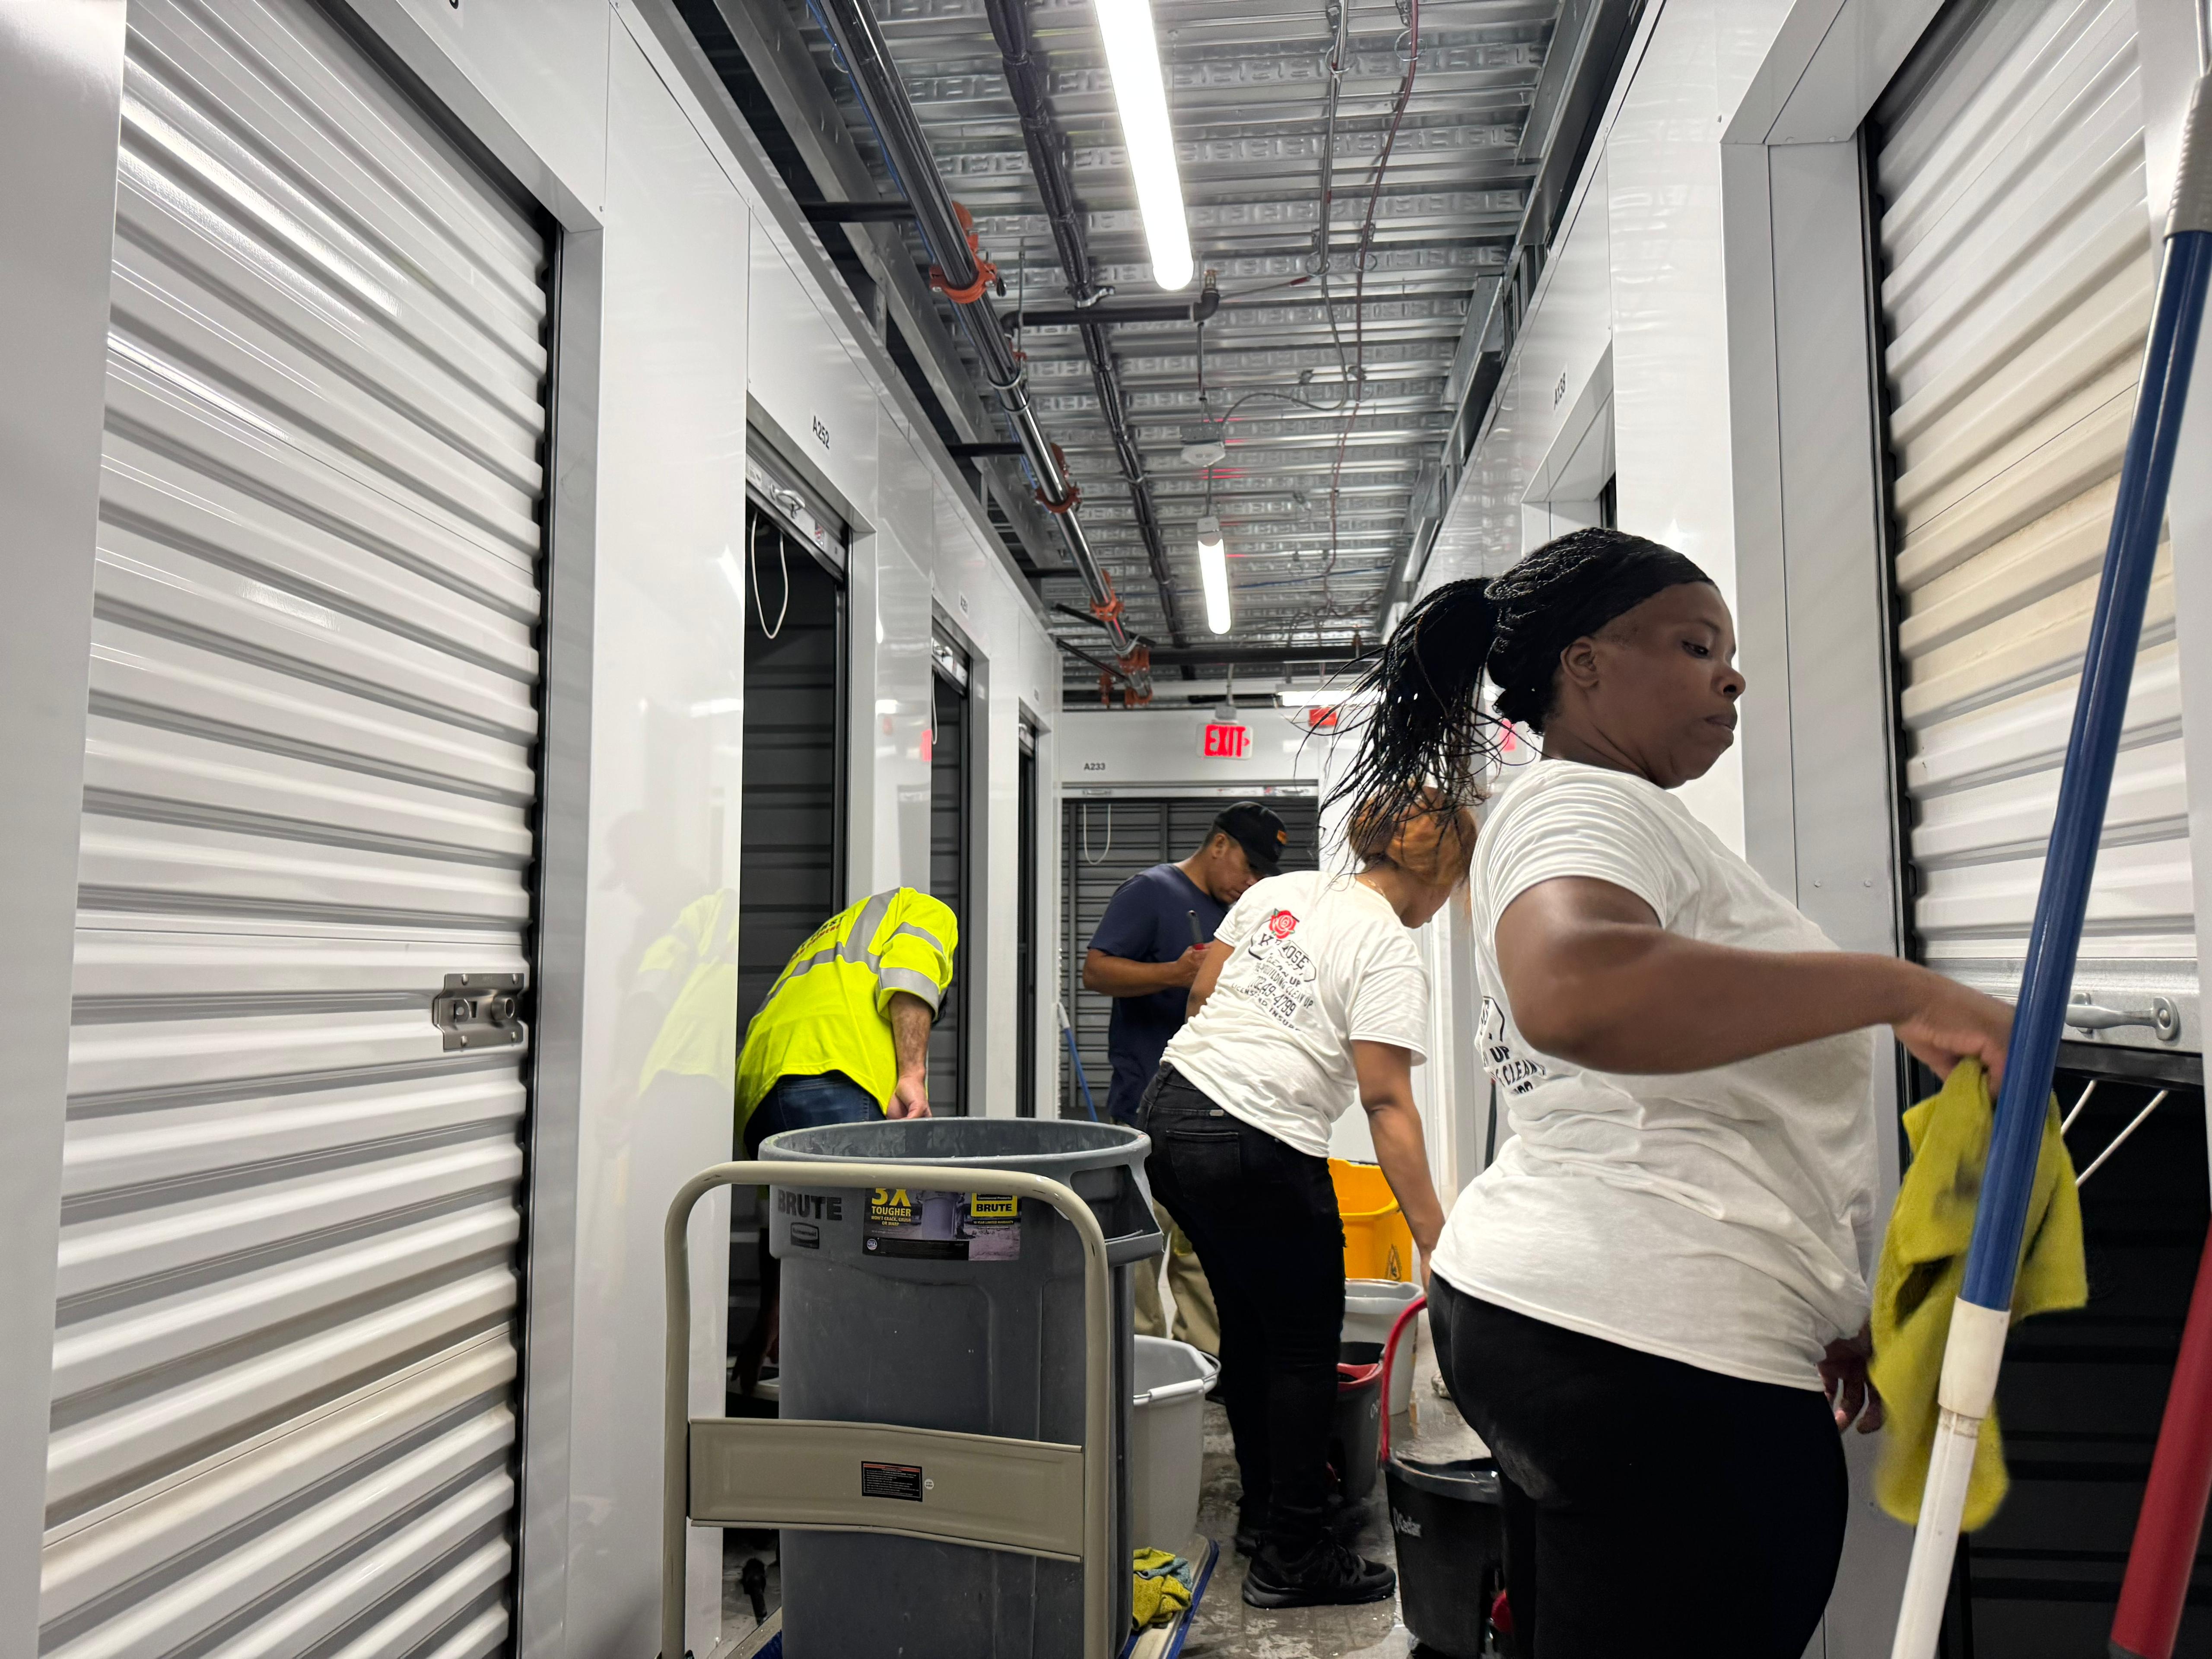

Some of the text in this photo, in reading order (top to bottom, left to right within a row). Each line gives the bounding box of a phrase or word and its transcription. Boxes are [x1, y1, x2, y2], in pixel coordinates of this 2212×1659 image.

[813, 415, 830, 450] A252
[1204, 724, 1246, 758] EXIT
[1084, 763, 1106, 771] A233
[1289, 976, 1301, 987] UP
[1303, 996, 1314, 1009] UP
[1490, 1045, 1510, 1063] UP
[1503, 1058, 1538, 1085] CLEAN
[778, 1189, 842, 1220] BRUTE
[871, 1206, 911, 1217] TOUGHER
[976, 1203, 1012, 1212] BRUTE
